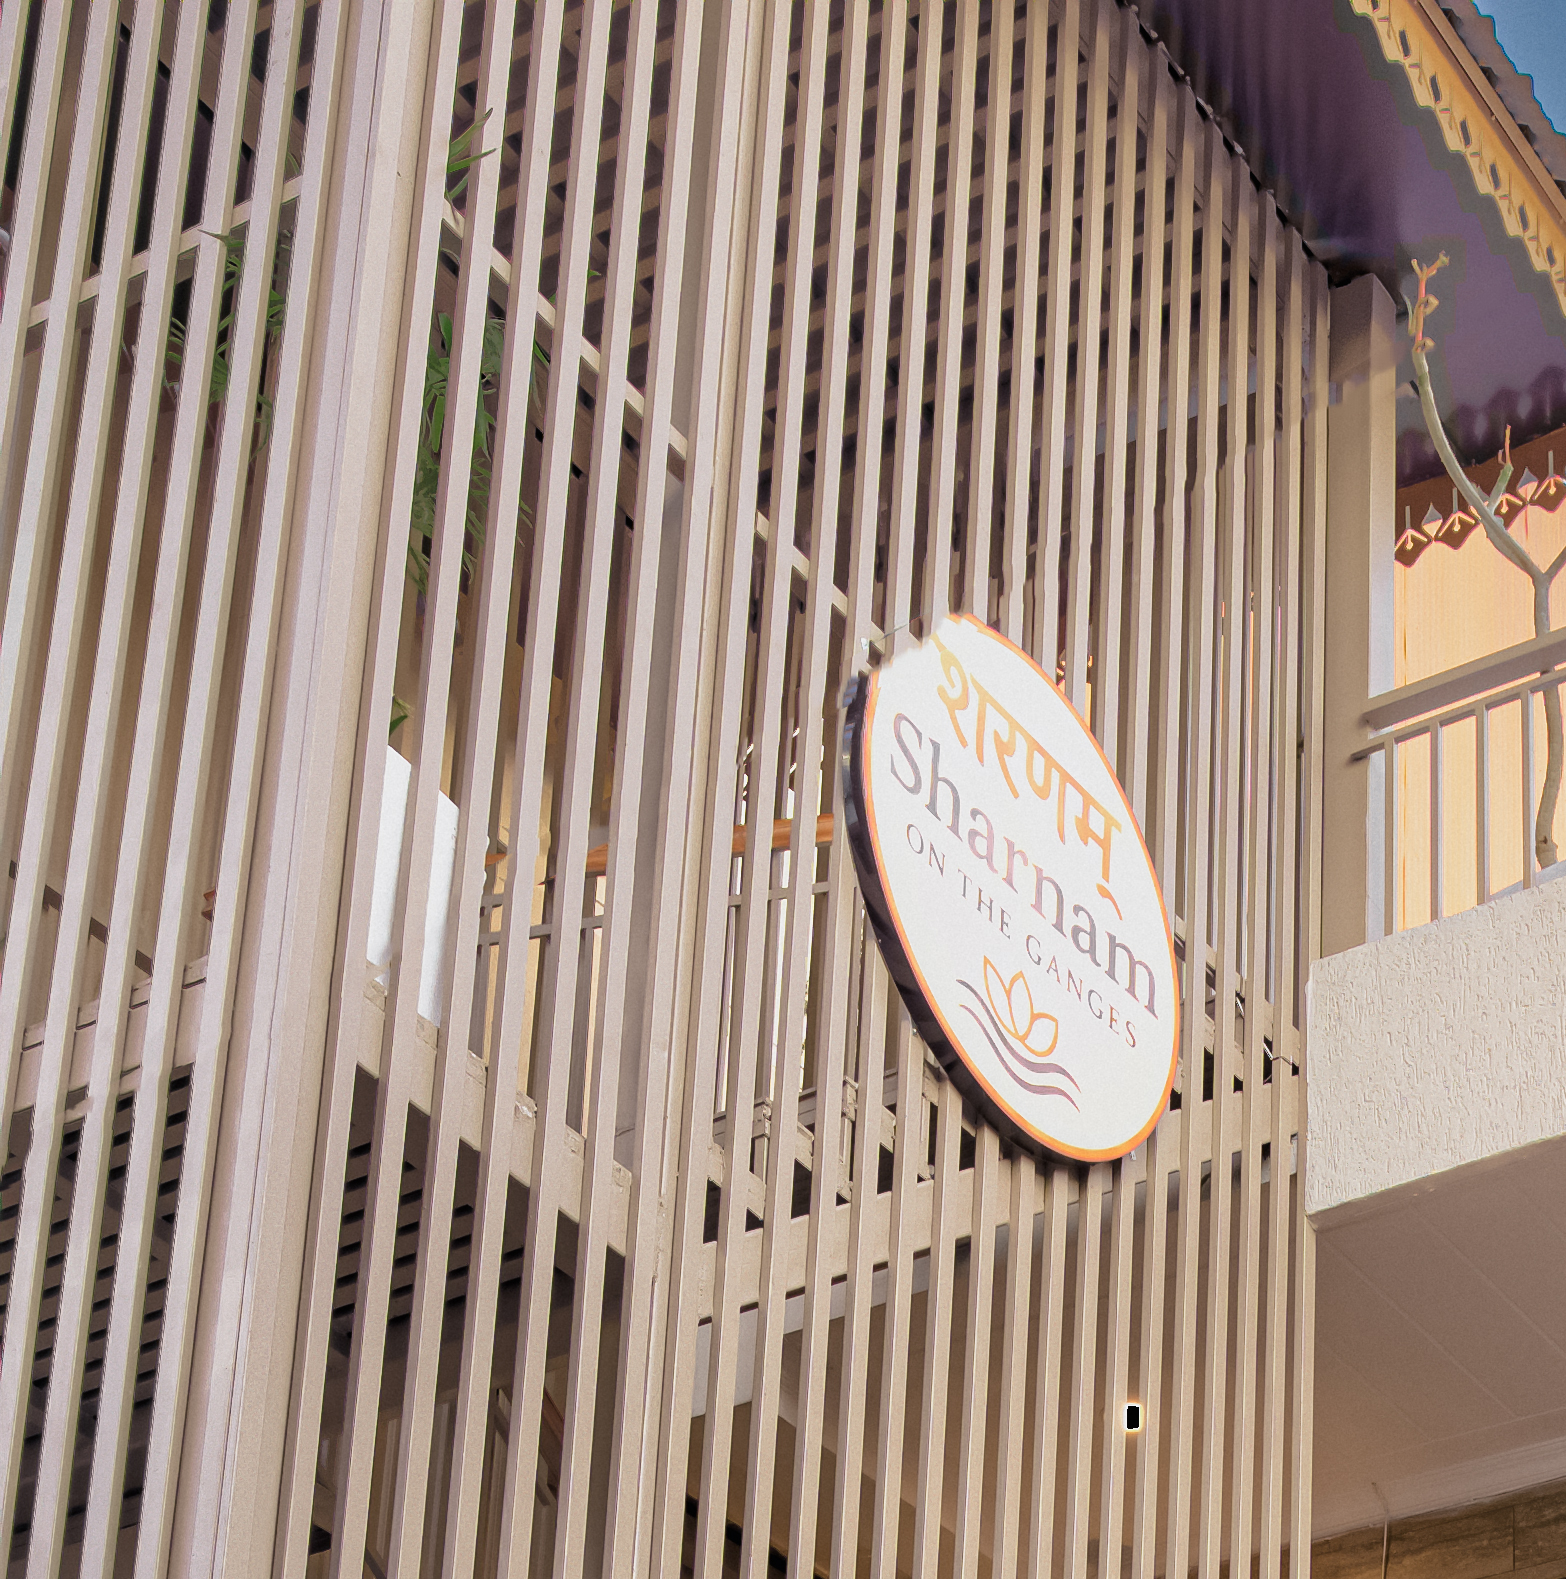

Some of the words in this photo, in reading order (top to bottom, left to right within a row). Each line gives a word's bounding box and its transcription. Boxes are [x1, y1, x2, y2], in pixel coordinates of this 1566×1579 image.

[890, 713, 1159, 1019] Sharnam
[930, 631, 1122, 920] शरणम्
[907, 823, 946, 877] ON
[957, 869, 1011, 941] THE
[1026, 934, 1137, 1048] GANGES
